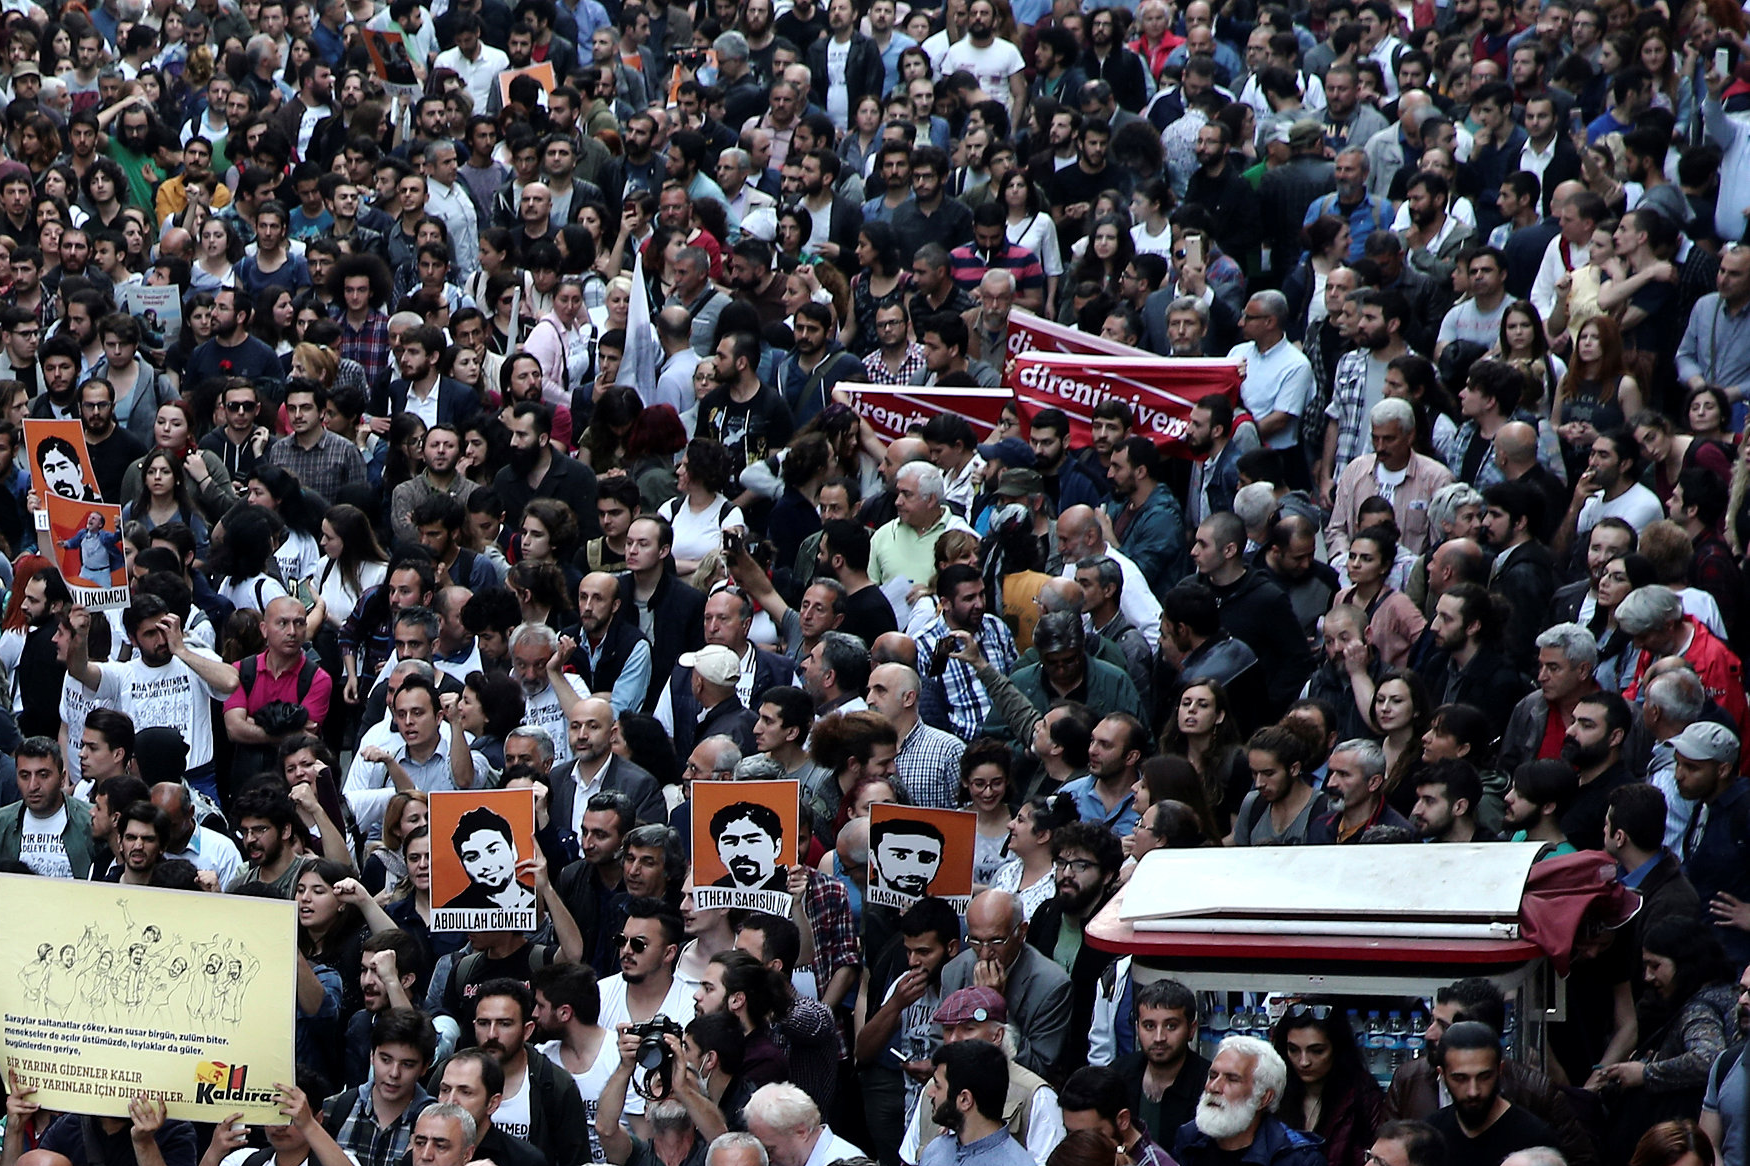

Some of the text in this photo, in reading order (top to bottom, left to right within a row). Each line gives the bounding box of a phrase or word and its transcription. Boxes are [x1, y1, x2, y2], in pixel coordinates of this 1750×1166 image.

[698, 889, 789, 917] ETHEM SARISÜLÜK
[434, 908, 533, 930] ABDULLAH CÖMERT
[4, 1013, 229, 1046] Saraylar saltanatlar çöker, kan susar birgün, zulüm biter.
[4, 1027, 204, 1056] menekşeler de açılır üstümüzde, leylaklar da güler.
[5, 1037, 81, 1056] bugünlerden geriye,
[6, 1054, 142, 1083] BİR YARINA GİDENLER KALIR
[29, 1076, 40, 1088] DE
[42, 1078, 92, 1095] YARINLAR
[94, 1080, 117, 1098] İÇİN
[195, 1064, 282, 1106] Kaldıraç
